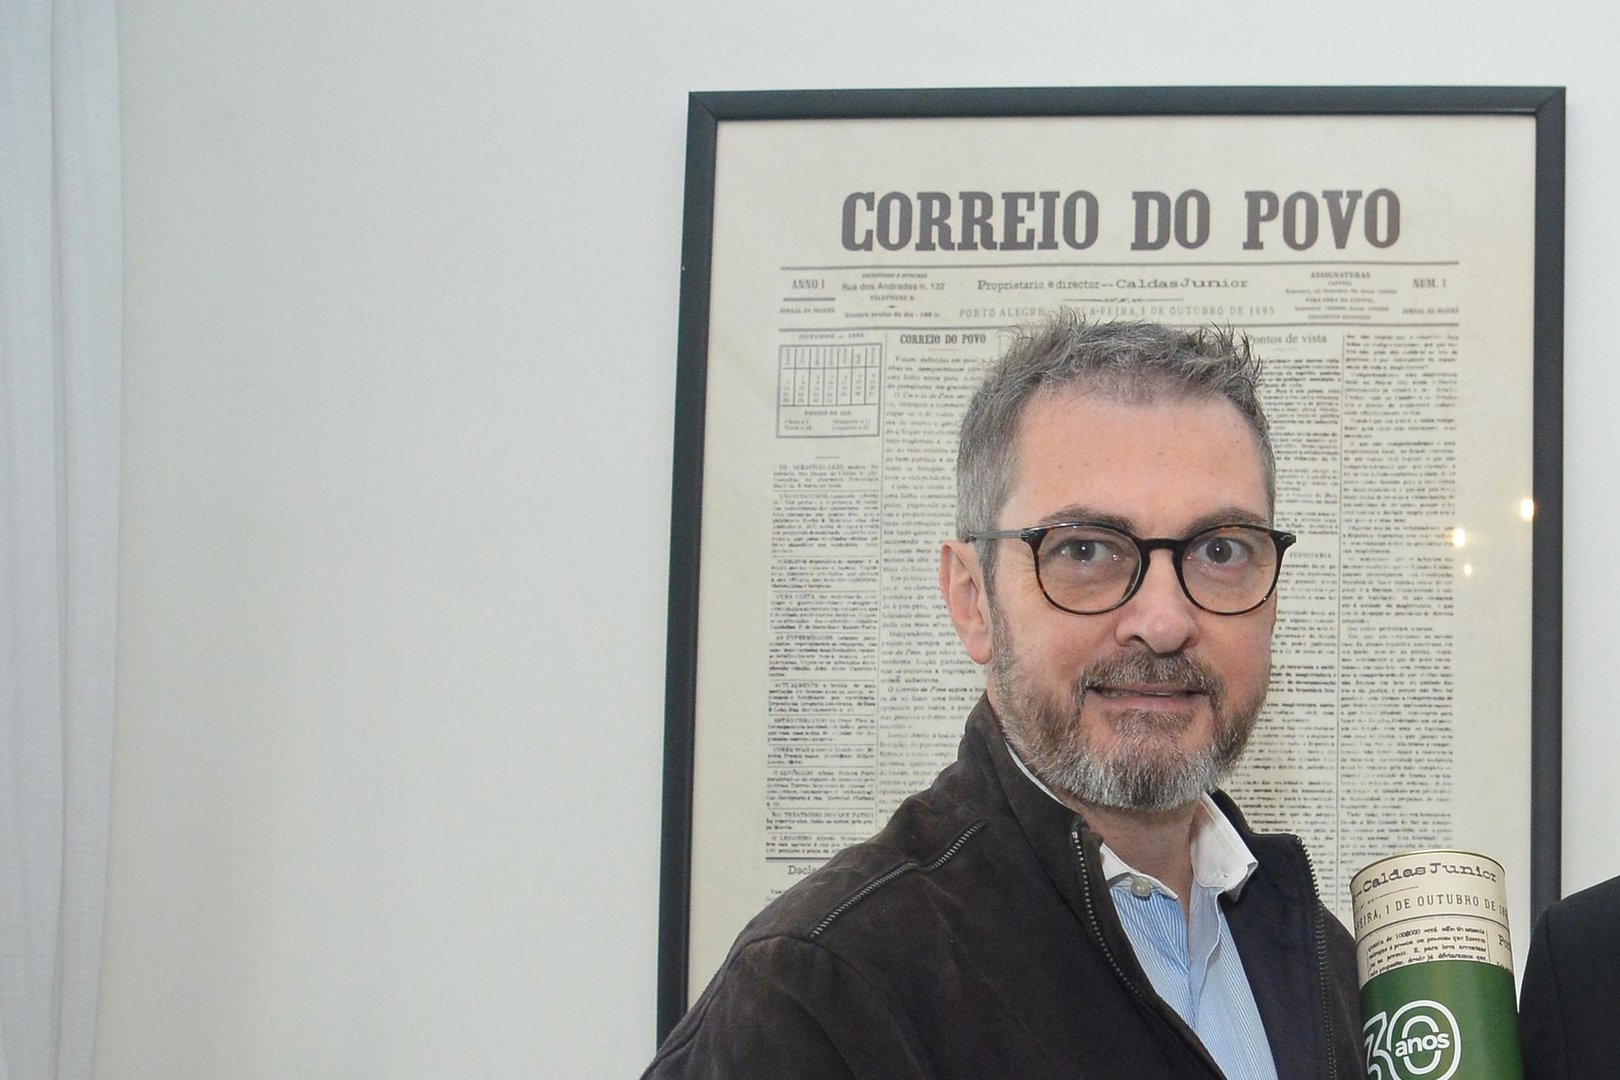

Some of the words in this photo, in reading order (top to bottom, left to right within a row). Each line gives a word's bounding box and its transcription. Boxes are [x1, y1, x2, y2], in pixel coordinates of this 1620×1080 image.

[841, 191, 1100, 252] CORREIO
[1130, 190, 1211, 251] DO
[1243, 188, 1402, 250] POVO
[791, 279, 819, 290] ANNO
[977, 279, 1044, 291] Proprietario
[1056, 279, 1100, 290] director
[1115, 278, 1178, 289] Caldas
[1180, 278, 1249, 289] Junior
[1413, 278, 1438, 289] NUM.
[960, 308, 995, 318] PORTO
[1000, 307, 1046, 317] ALEGRE
[1151, 306, 1165, 316] DE
[1169, 306, 1224, 316] OUTUBRO
[1230, 306, 1244, 316] DE
[900, 334, 941, 344] CORREIO
[945, 334, 958, 344] DO
[962, 334, 986, 343] POVO
[1286, 333, 1298, 344] de
[1302, 333, 1327, 344] vista
[1363, 864, 1426, 892] Caldas
[1429, 863, 1497, 882] Junior
[1395, 899, 1410, 911] DE
[1417, 894, 1479, 906] OUTUBRO
[1485, 899, 1496, 911] DE
[1395, 1031, 1450, 1057] anos
